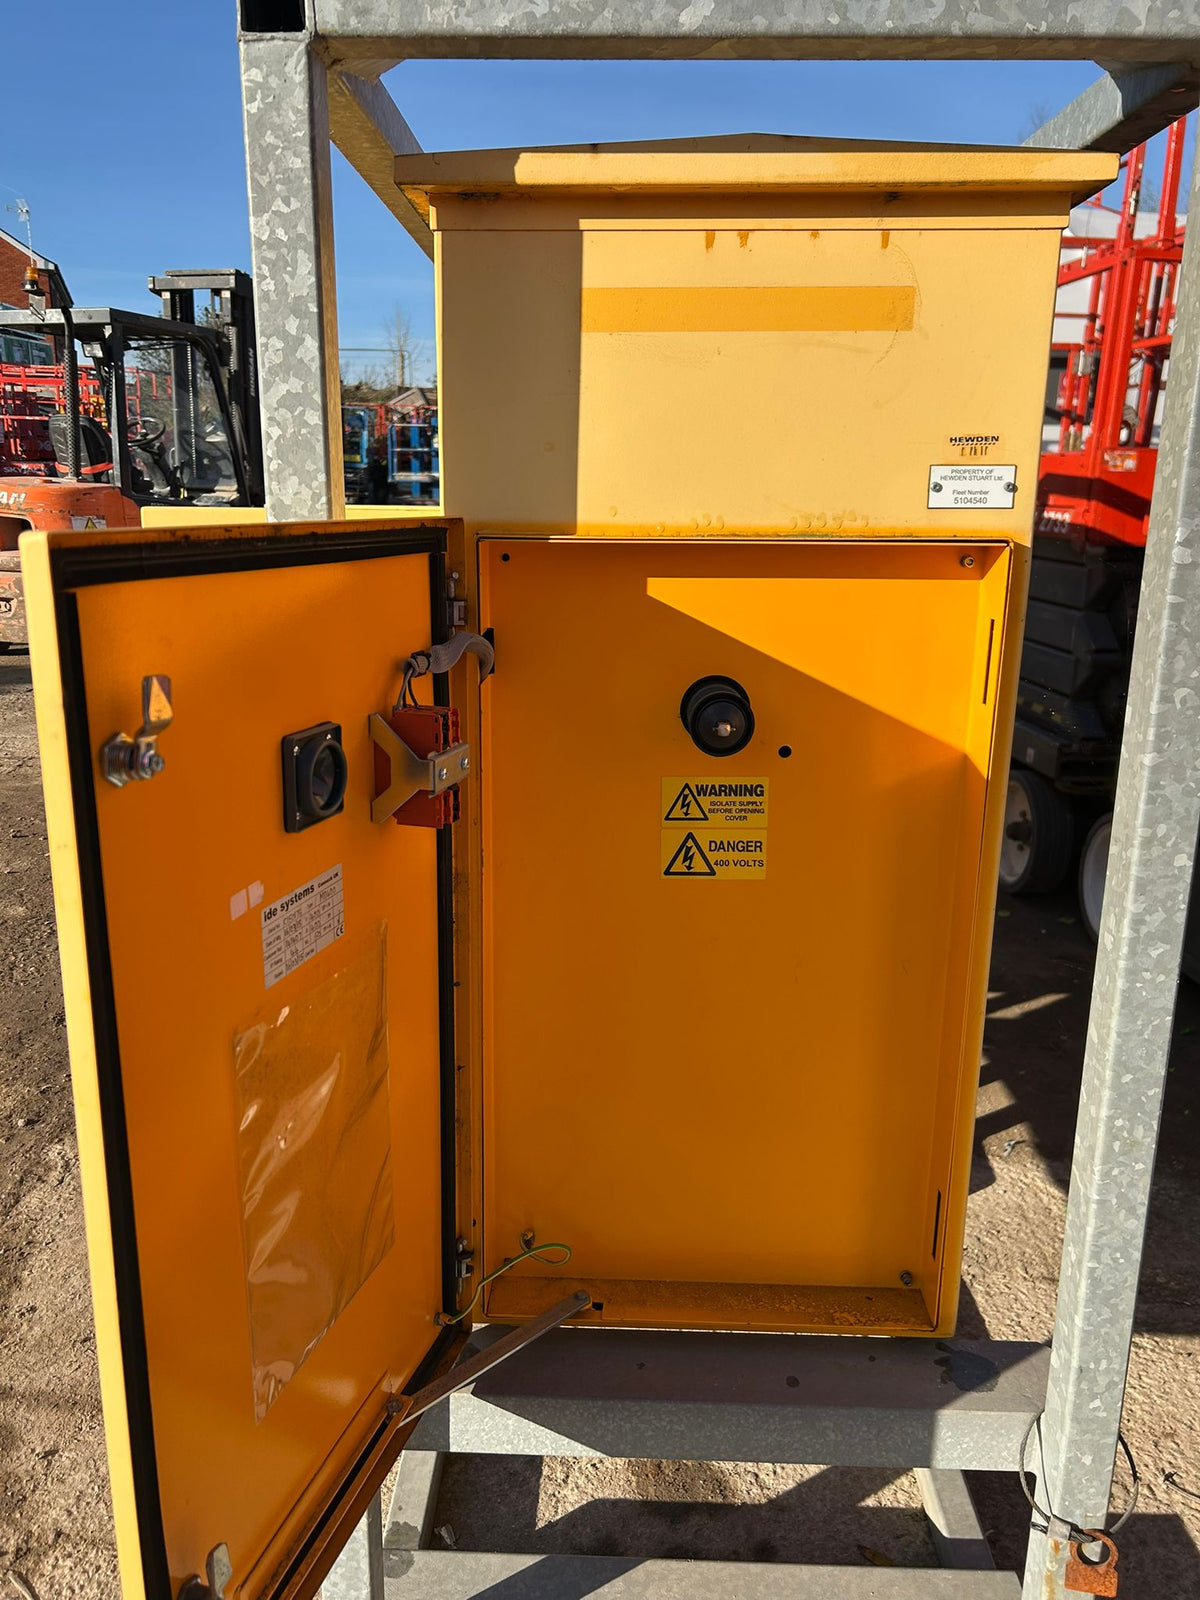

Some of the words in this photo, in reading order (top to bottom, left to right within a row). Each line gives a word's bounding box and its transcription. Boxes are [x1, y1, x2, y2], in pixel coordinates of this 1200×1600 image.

[949, 435, 1000, 444] HEWDEN
[953, 496, 988, 505] 5104540
[695, 784, 765, 797] WARNING
[708, 840, 763, 853] DANGER
[713, 859, 730, 867] 400
[732, 859, 764, 867] VOLTS
[263, 907, 278, 922] ide
[280, 884, 315, 912] systems
